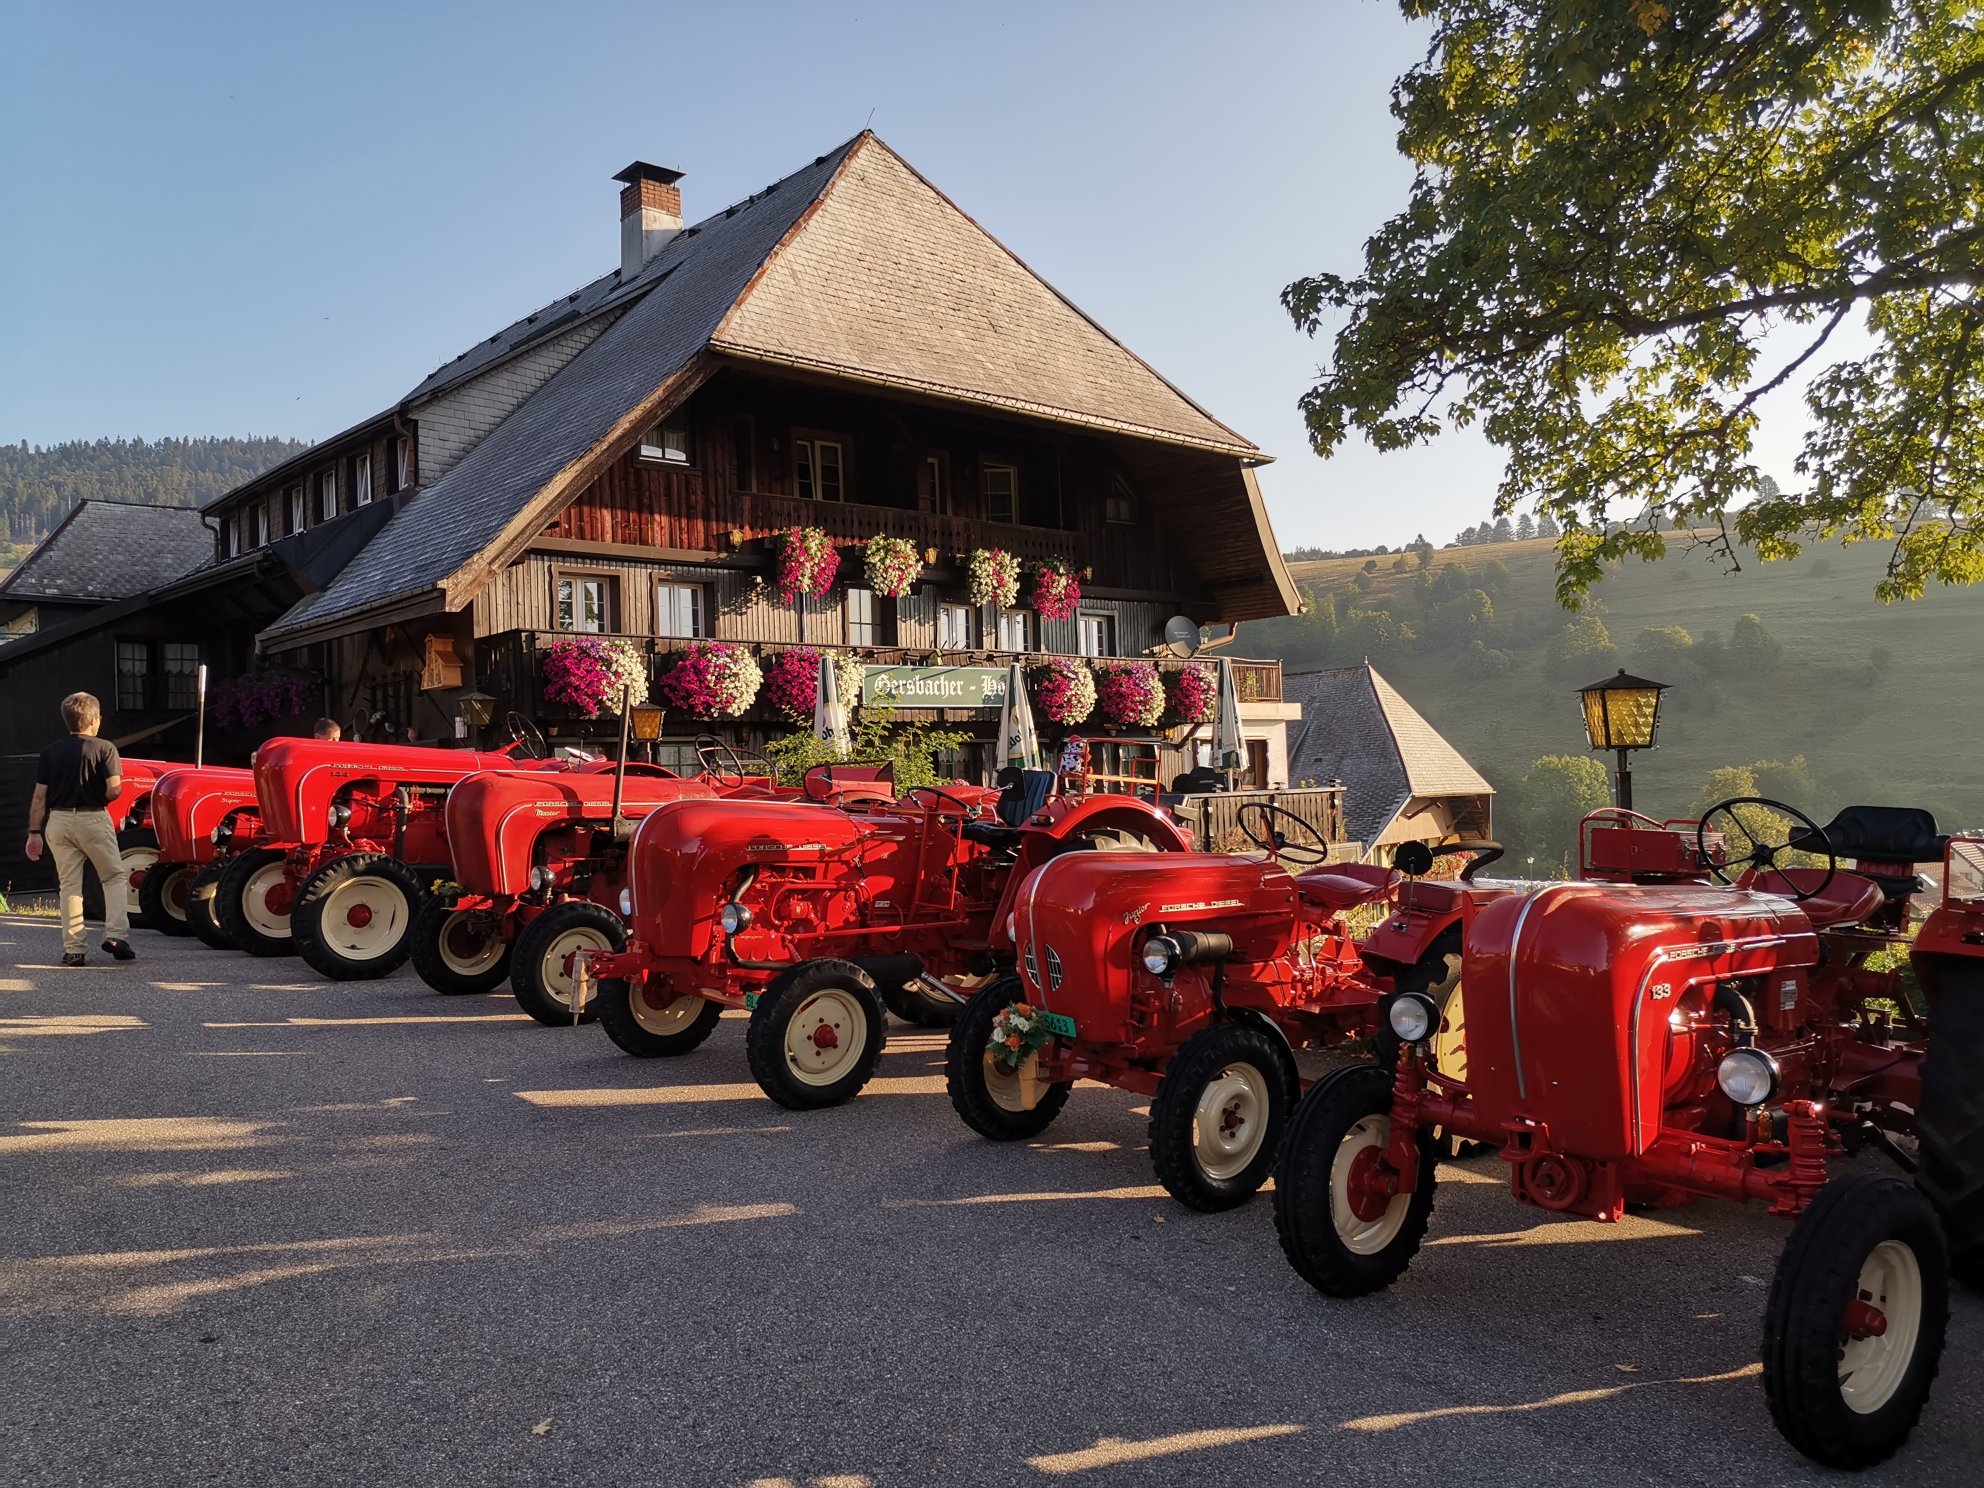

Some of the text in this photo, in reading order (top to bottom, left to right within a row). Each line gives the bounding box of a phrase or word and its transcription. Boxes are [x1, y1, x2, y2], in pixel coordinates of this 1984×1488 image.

[874, 673, 964, 699] Gersbacher
[980, 674, 1006, 700] Ho
[220, 797, 242, 805] Super
[534, 808, 560, 817] Master
[1160, 899, 1241, 912] PORSCHE DIESEL
[1122, 902, 1151, 925] Junior
[1668, 946, 1709, 961] PORSCHE
[1650, 982, 1672, 1000] 133
